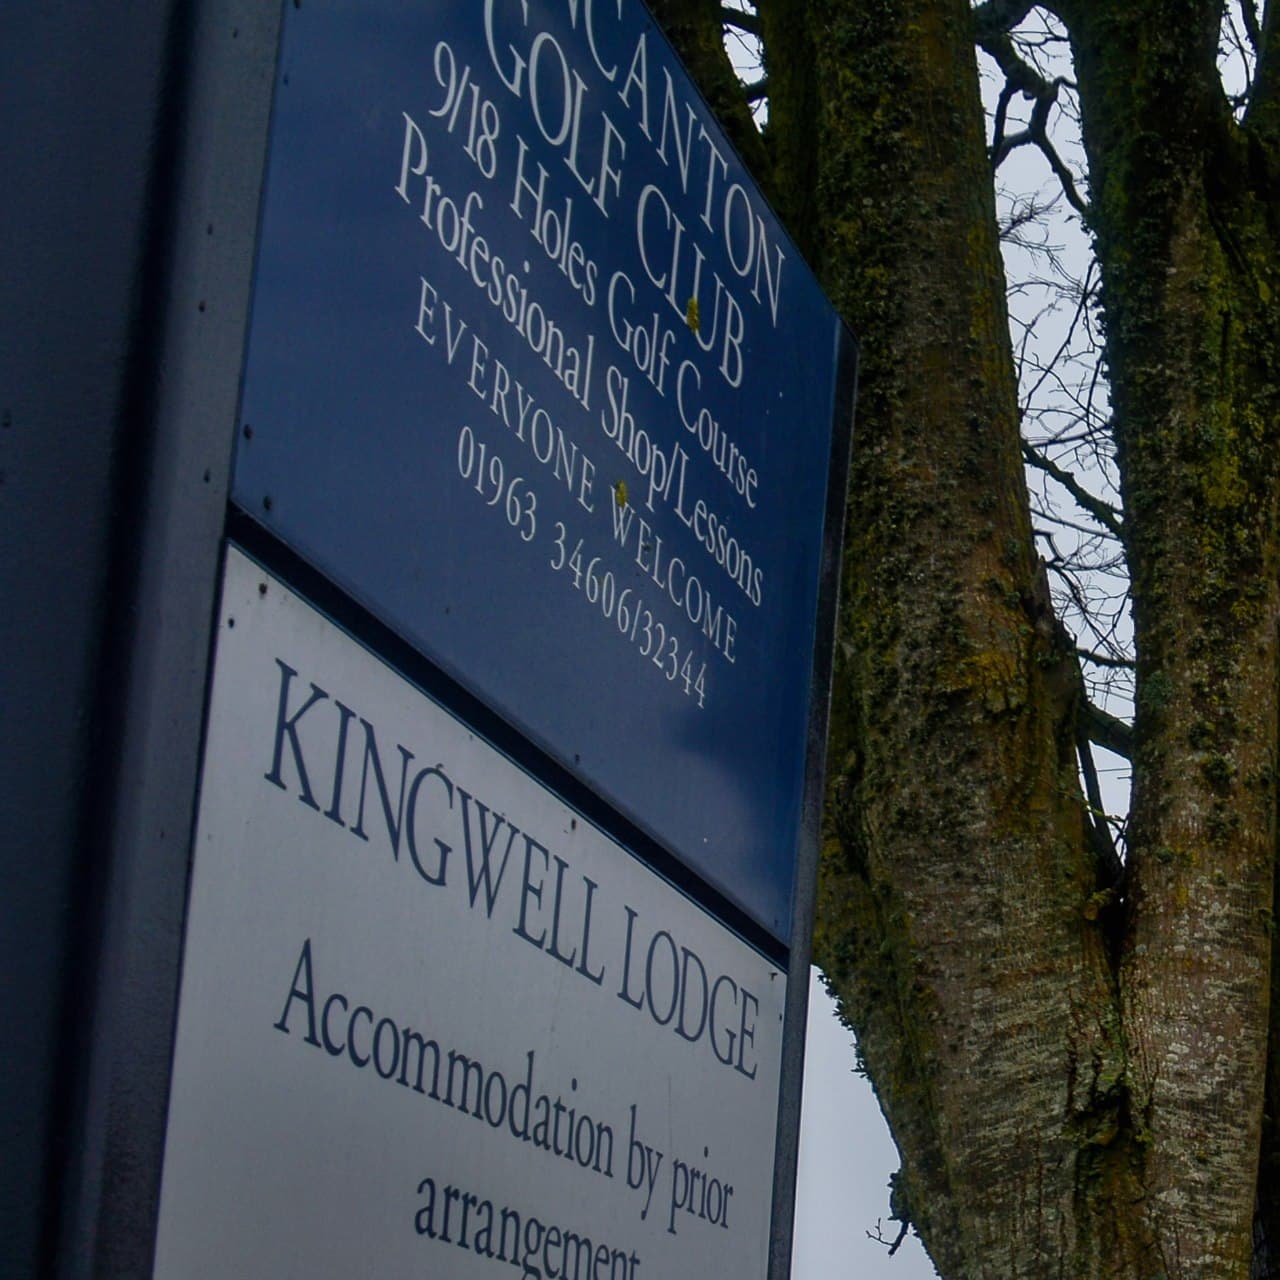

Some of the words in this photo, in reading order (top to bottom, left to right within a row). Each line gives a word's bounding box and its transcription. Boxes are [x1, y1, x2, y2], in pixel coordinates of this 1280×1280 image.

[429, 41, 500, 179] 9/18
[510, 134, 598, 306] Holes
[608, 271, 675, 397] Golf
[677, 360, 758, 509] Course
[484, 0, 627, 219] GOLF
[637, 184, 745, 389] CLUB
[568, 0, 787, 329] CANTON
[394, 111, 595, 411] Professional
[601, 366, 764, 607] Shop/Lessons
[415, 276, 596, 514] EVERYONE
[610, 484, 737, 663] WELCOME
[458, 426, 536, 541] 01963
[550, 522, 707, 709] 34606/32344
[264, 657, 605, 986] KINGWELL
[617, 905, 759, 1080] LODGE
[273, 938, 614, 1178] Accommodation
[626, 1105, 663, 1221] by
[668, 1147, 734, 1234] prior
